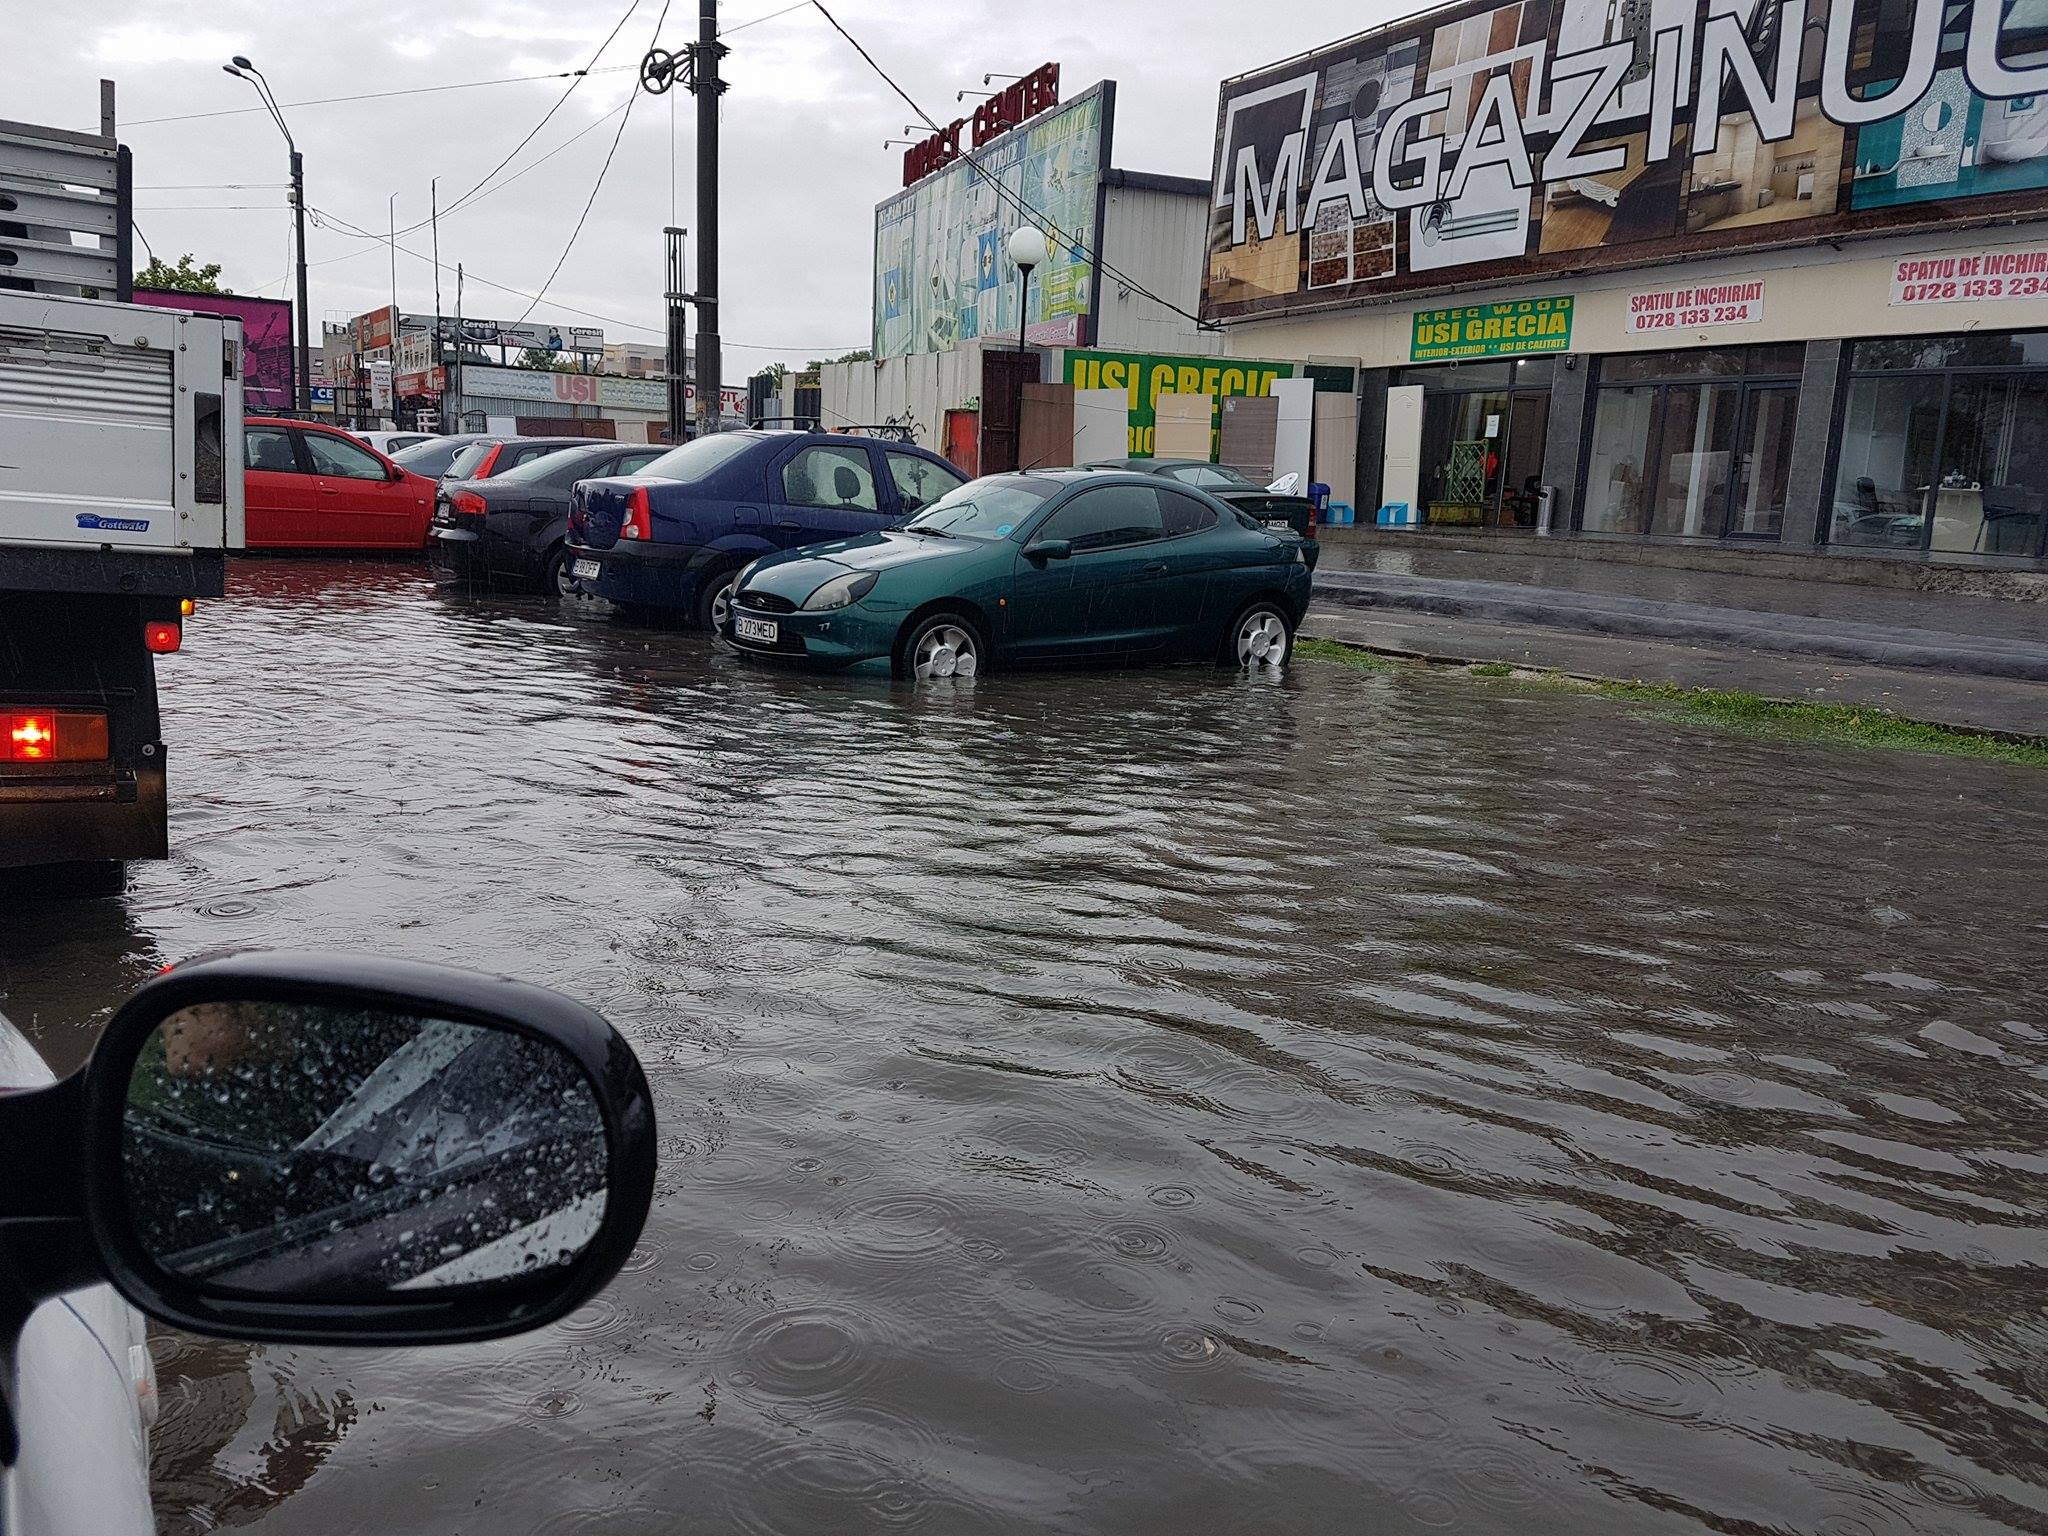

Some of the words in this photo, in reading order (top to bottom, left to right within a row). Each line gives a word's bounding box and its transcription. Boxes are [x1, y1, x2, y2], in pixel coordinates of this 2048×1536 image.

[972, 62, 1060, 147] CENTER
[1897, 258, 1955, 282] SPATIU
[1959, 256, 1981, 277] DE
[1983, 252, 2048, 275] INCHIR
[1631, 292, 1675, 313] SPATIU
[1676, 290, 1692, 308] DE
[1695, 282, 1763, 306] INCHIRIAT
[1902, 282, 1957, 301] 0728
[1962, 279, 2003, 297] 133
[1418, 308, 1479, 323] KREG
[1493, 299, 1570, 315] WOOD
[1636, 312, 1675, 329] 0728
[1679, 309, 1710, 325] 133
[1714, 305, 1748, 322] 234
[462, 319, 497, 329] Ceresit
[1417, 322, 1460, 345] USI
[1465, 312, 1567, 341] GRECIA
[1528, 339, 1567, 350] CALITATE
[555, 374, 597, 402] USI
[98, 519, 147, 531] Gottwald
